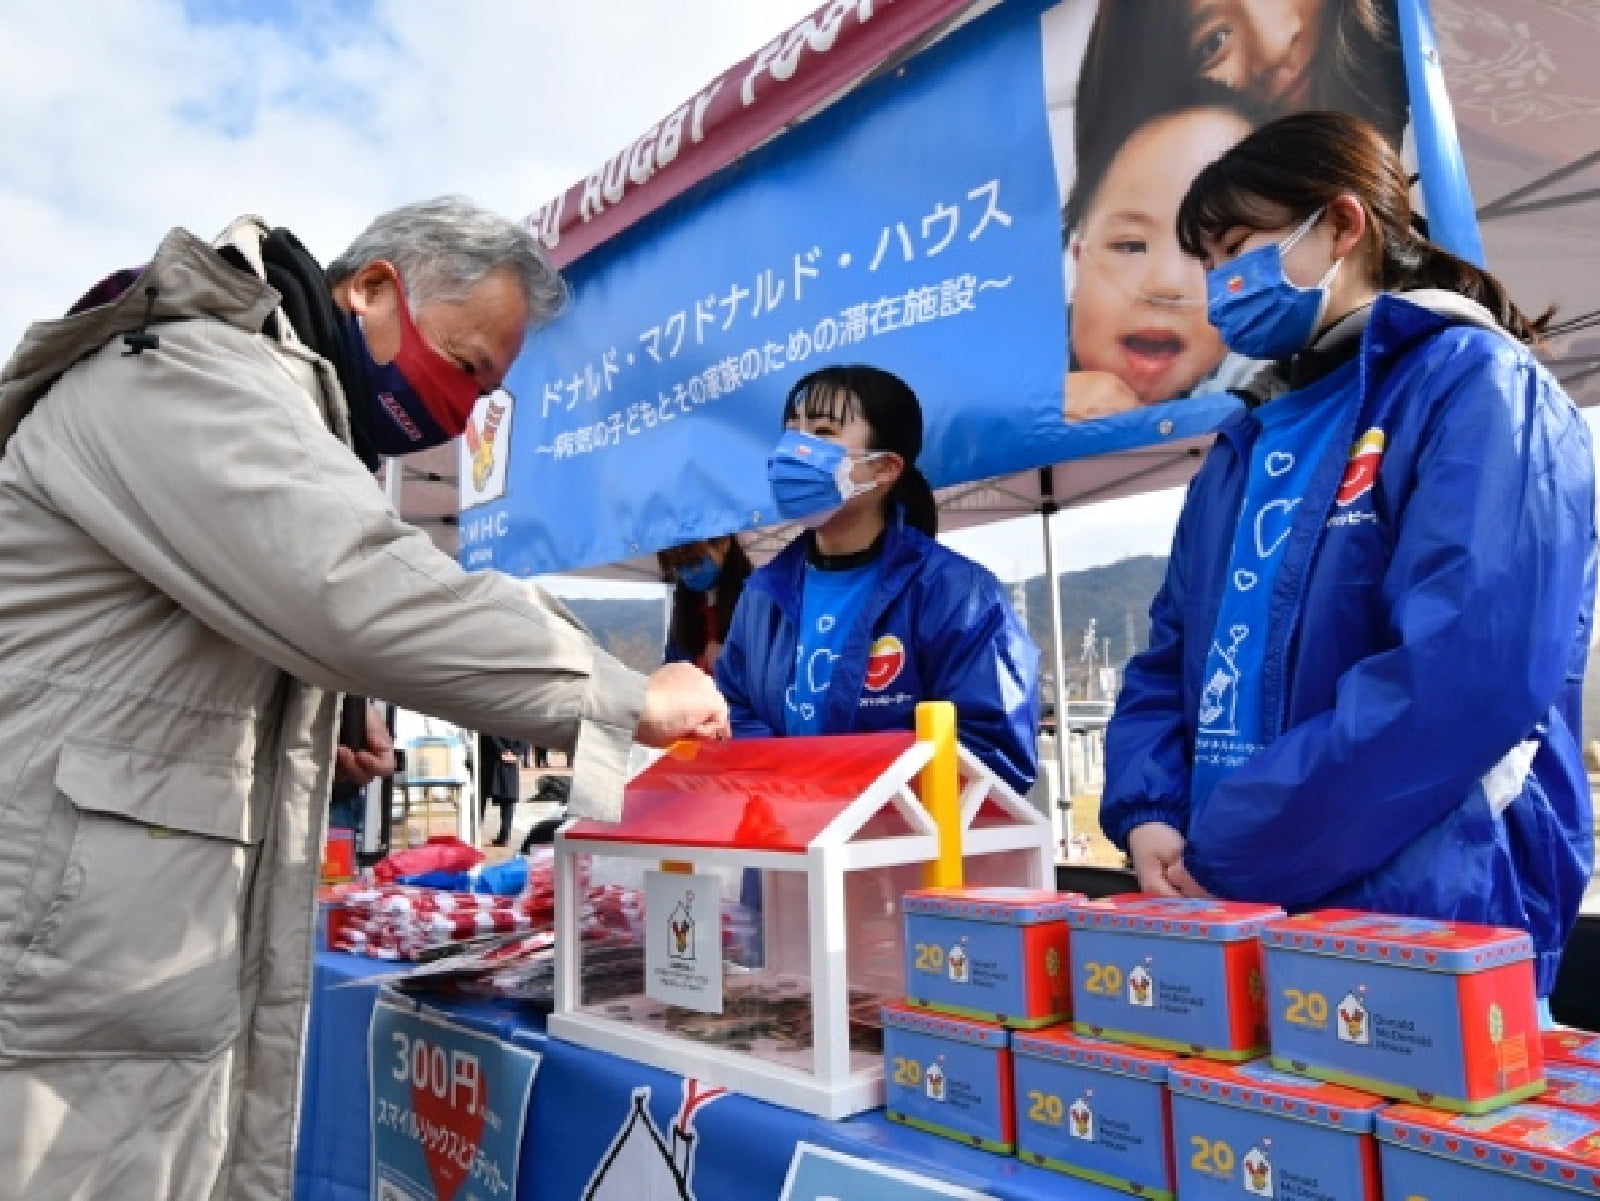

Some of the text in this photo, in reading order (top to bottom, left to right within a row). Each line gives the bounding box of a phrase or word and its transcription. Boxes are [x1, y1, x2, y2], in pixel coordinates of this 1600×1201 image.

[578, 78, 727, 223] RUGBY
[541, 178, 1014, 418] ドナルド・マクドナルド・ハウス
[915, 943, 944, 971] 20
[1084, 961, 1124, 995] 20
[1282, 988, 1329, 1024] 20
[392, 1032, 479, 1114] 300円
[892, 1057, 922, 1086] 20
[1026, 1090, 1063, 1124] 20
[1190, 1135, 1236, 1172] 20
